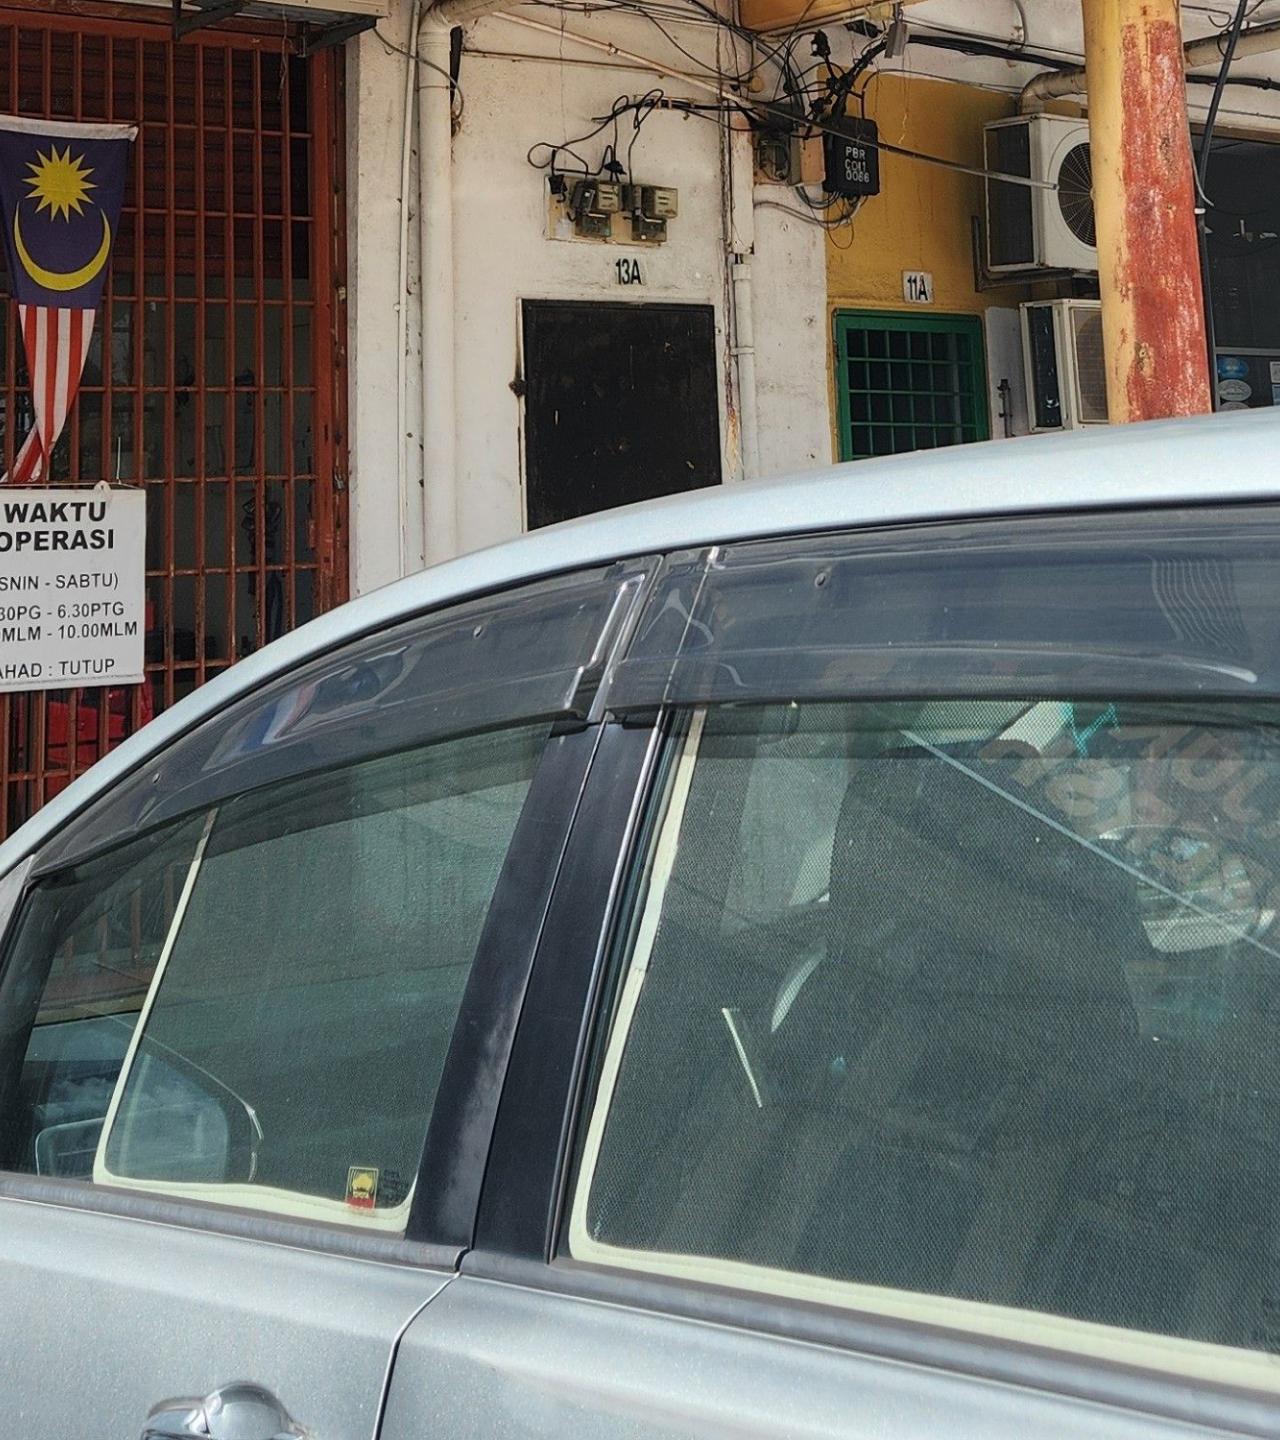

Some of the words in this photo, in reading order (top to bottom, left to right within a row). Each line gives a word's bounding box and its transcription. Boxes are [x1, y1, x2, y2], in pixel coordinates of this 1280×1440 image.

[845, 146, 866, 160] PBR
[615, 258, 642, 285] 13A
[907, 274, 929, 301] 11A
[4, 501, 107, 524] WAKTU
[55, 572, 119, 592] SABTU)
[57, 601, 125, 619] 6.30PTG
[58, 621, 138, 640] 10.00MLM
[59, 658, 116, 676] TUTUP
